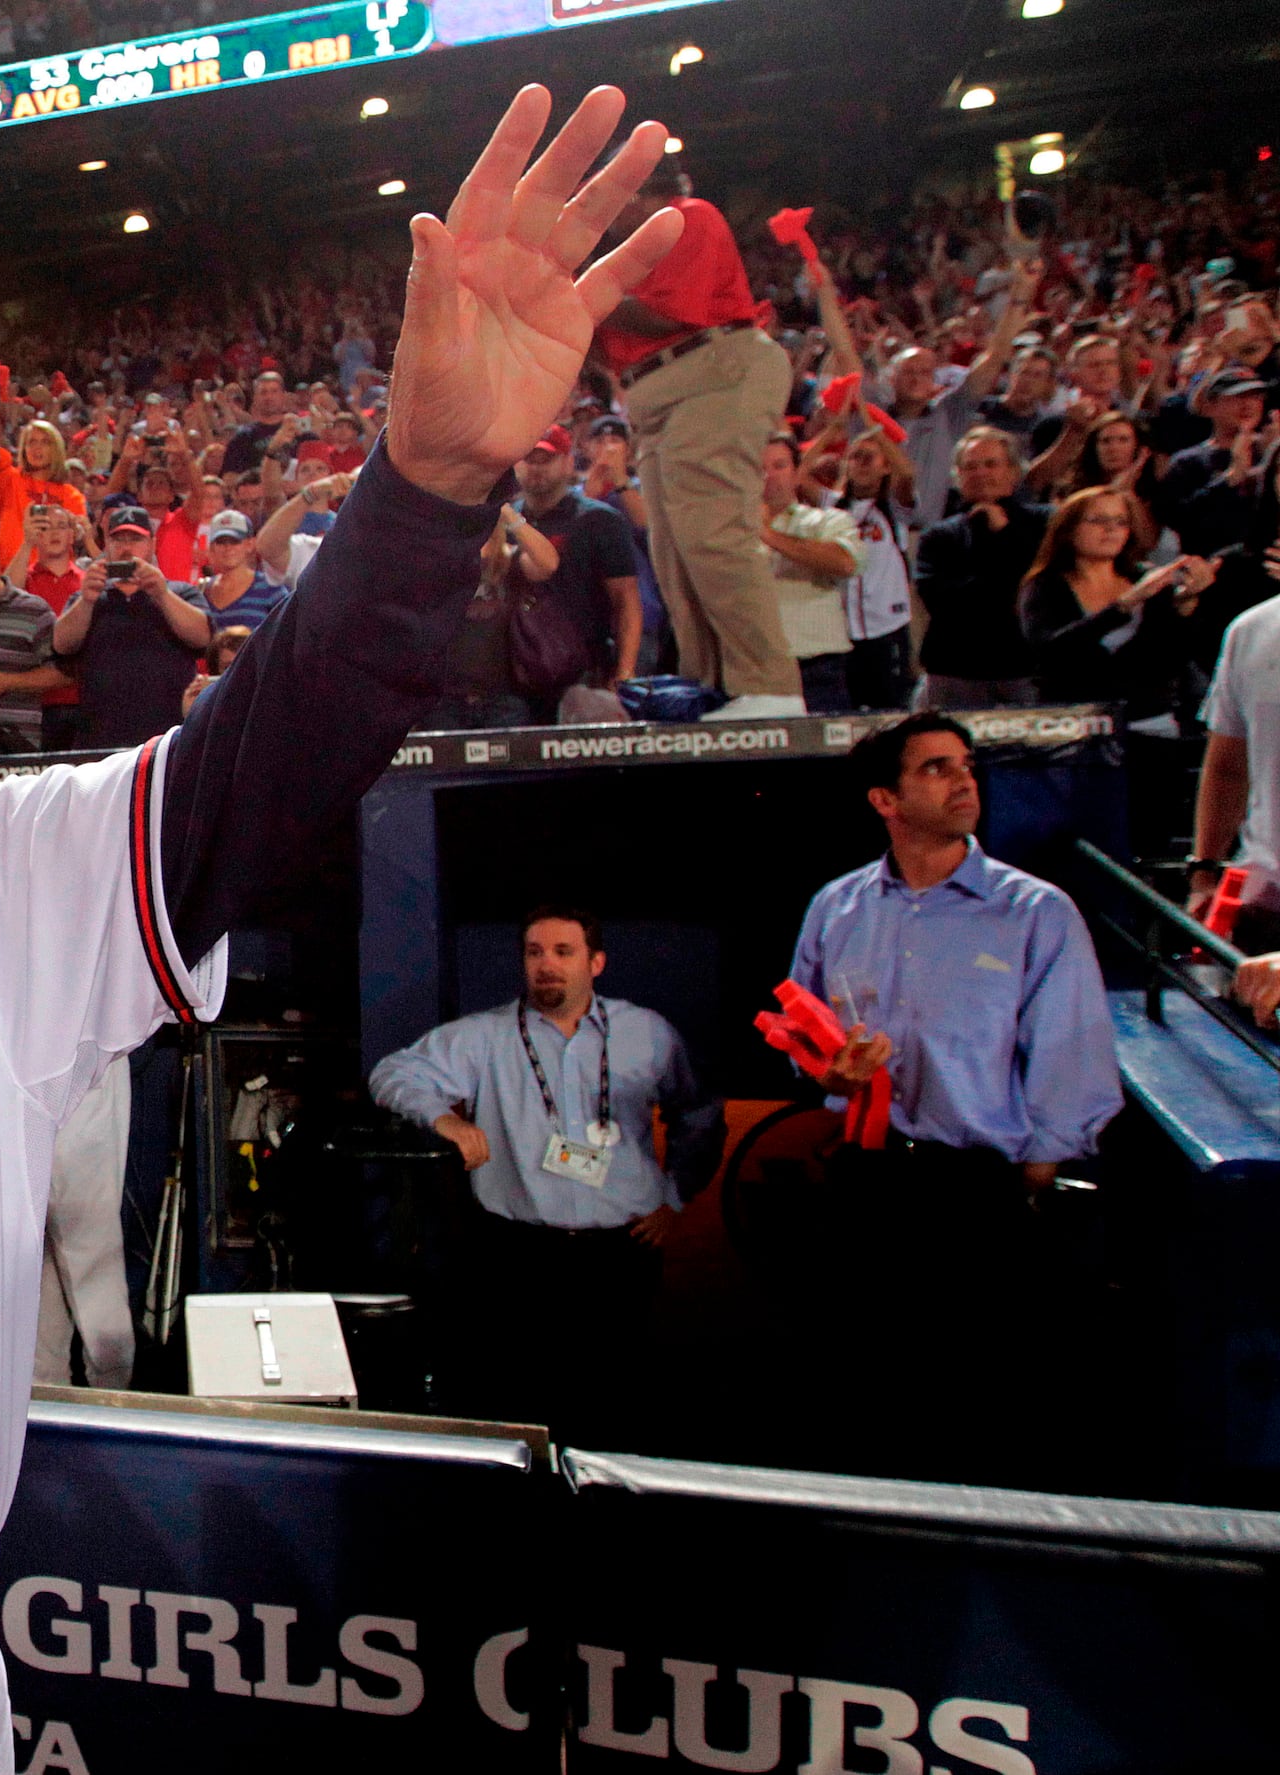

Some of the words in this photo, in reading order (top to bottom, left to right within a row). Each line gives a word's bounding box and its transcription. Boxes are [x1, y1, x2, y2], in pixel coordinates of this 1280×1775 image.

[12, 84, 80, 118] AVG
[89, 71, 154, 107] .000
[170, 59, 221, 90] HR
[243, 50, 266, 78] 0
[288, 34, 350, 70] RBI
[374, 28, 395, 57] 1
[30, 59, 70, 90] 53
[78, 35, 220, 80] Cabrera
[541, 726, 789, 758] neweracap.com
[2, 1575, 425, 1716] GIRLS
